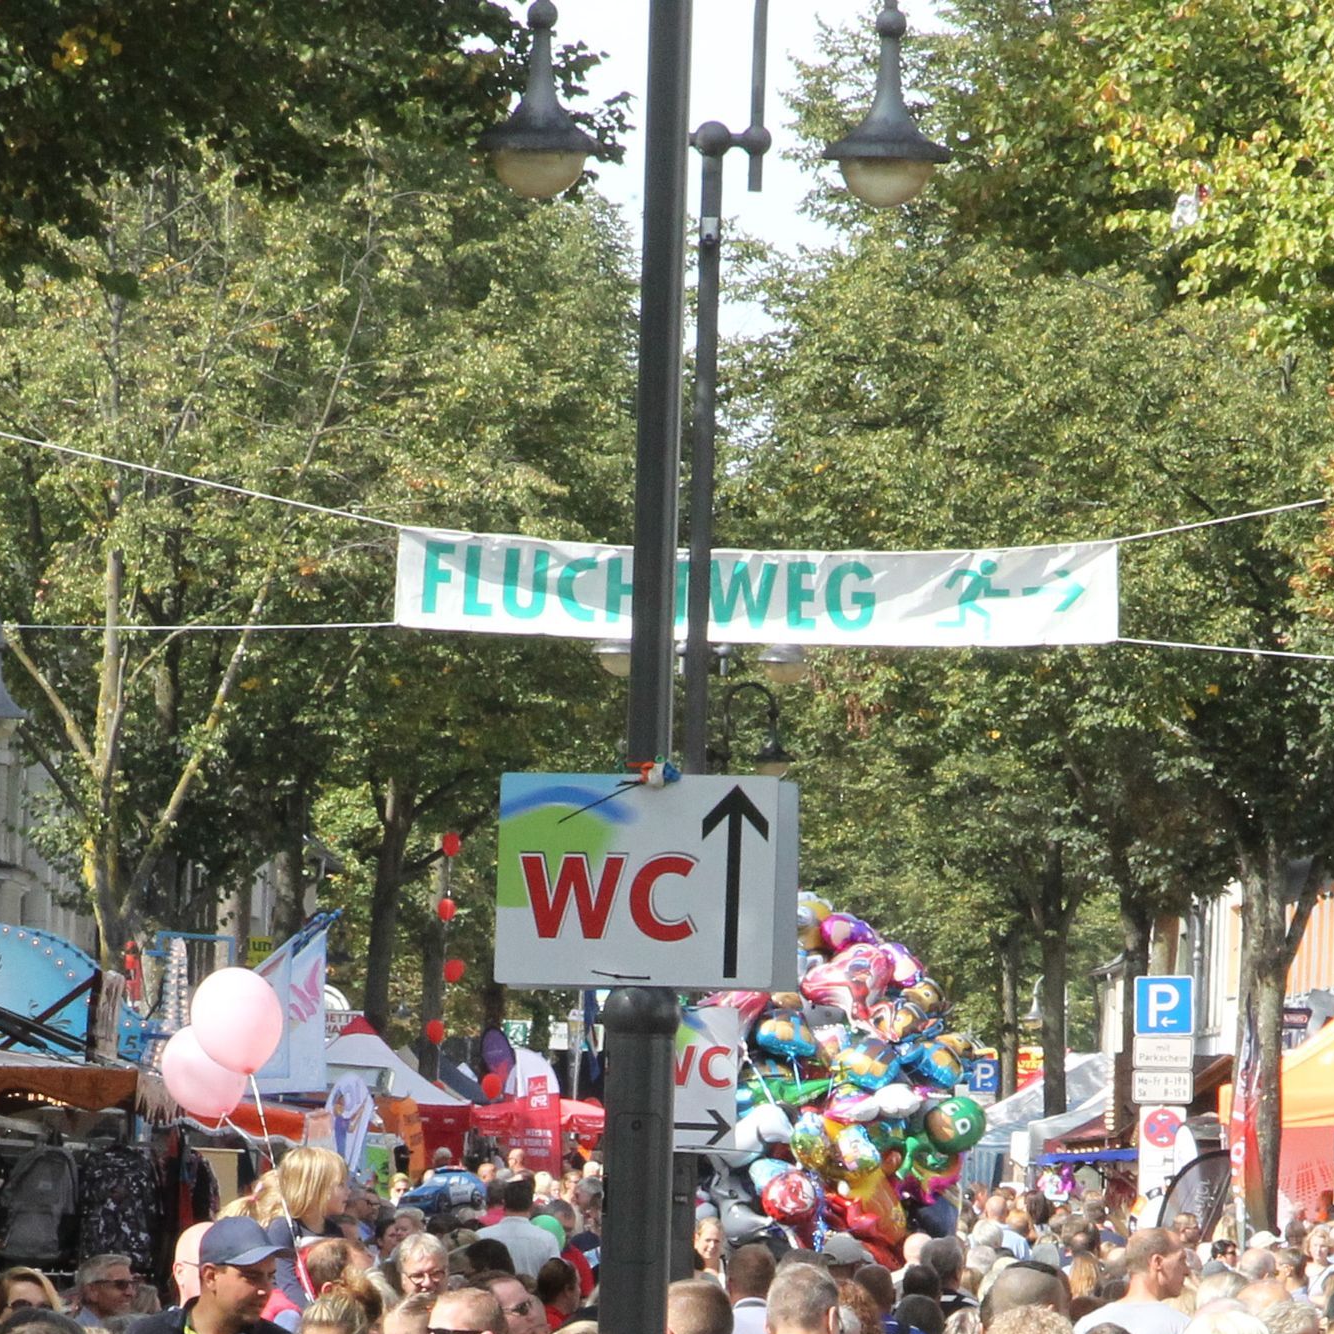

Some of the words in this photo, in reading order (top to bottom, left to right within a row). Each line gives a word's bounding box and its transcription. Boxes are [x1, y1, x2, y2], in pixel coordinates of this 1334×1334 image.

[519, 852, 699, 942] WC
[1148, 984, 1180, 1028] P
[1138, 1052, 1188, 1062] Parkschein
[976, 1063, 995, 1088] P
